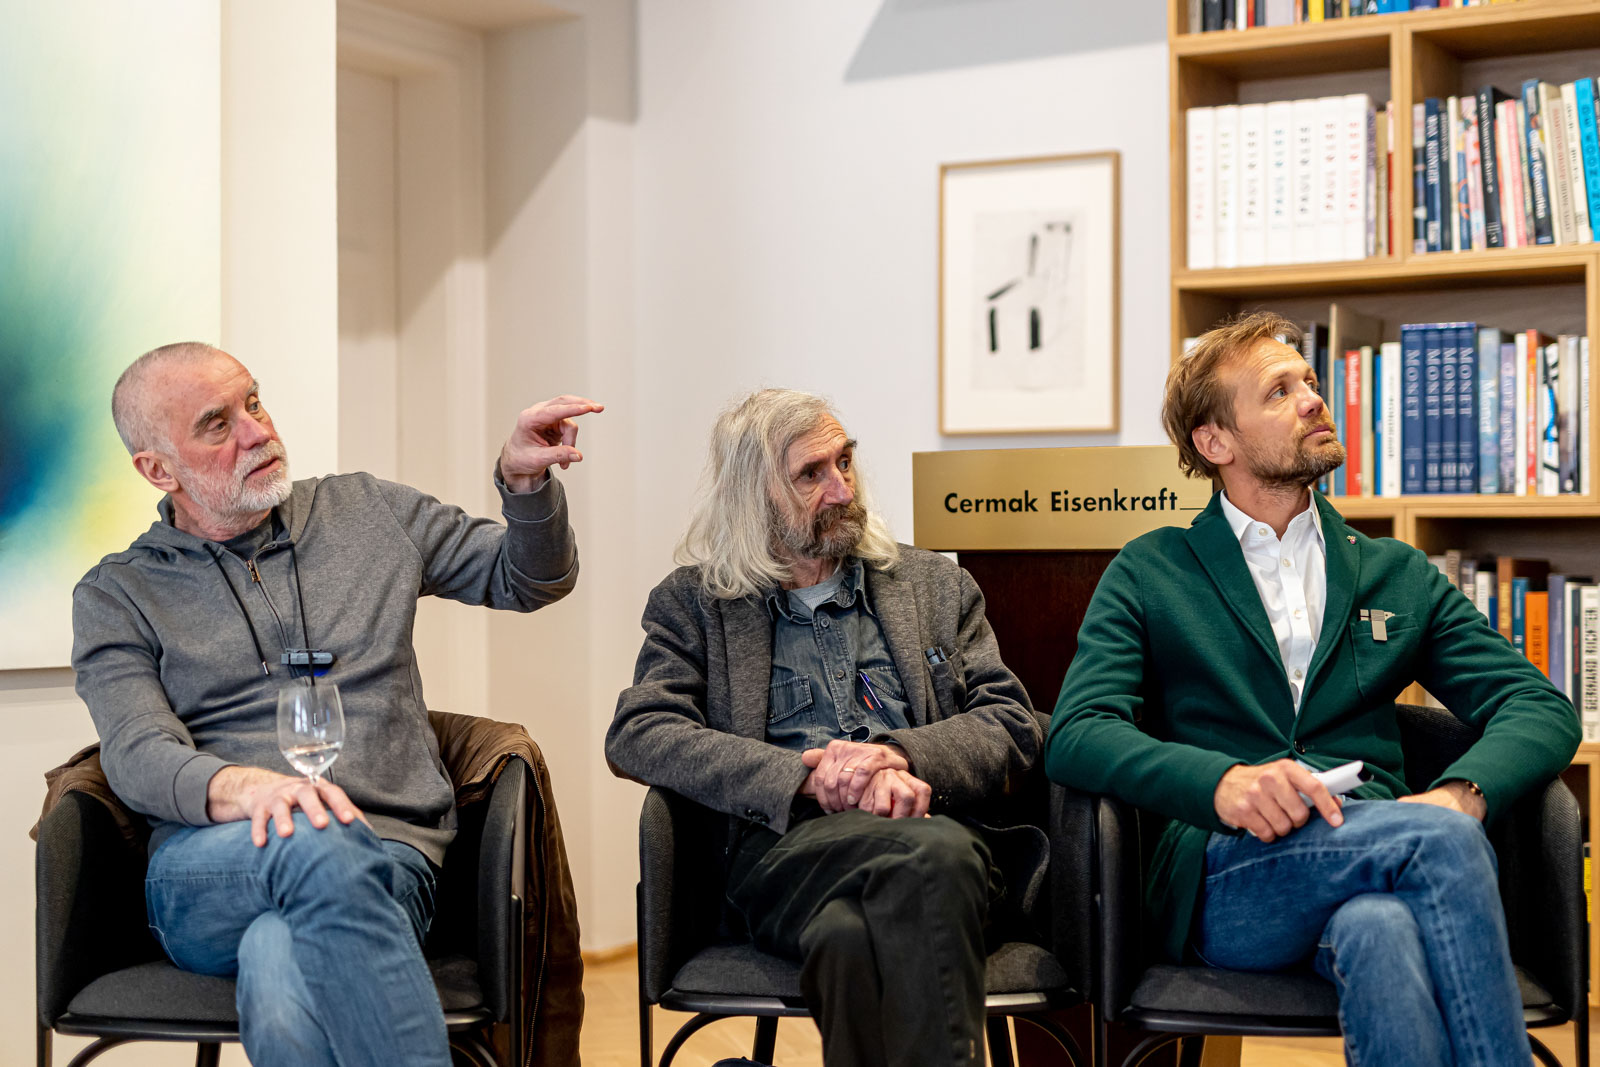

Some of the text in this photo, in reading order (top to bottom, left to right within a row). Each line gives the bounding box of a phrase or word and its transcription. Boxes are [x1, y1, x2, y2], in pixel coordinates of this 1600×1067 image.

[1406, 348, 1420, 420] MONET
[1426, 347, 1441, 419] MONET
[1443, 346, 1457, 419] MONET
[1459, 346, 1474, 418] MONET
[1480, 378, 1496, 434] Monet
[944, 487, 1178, 514] Cermak Eisenkraft
[1585, 607, 1598, 656] RICHTER
[1585, 657, 1598, 712] GERHARD
